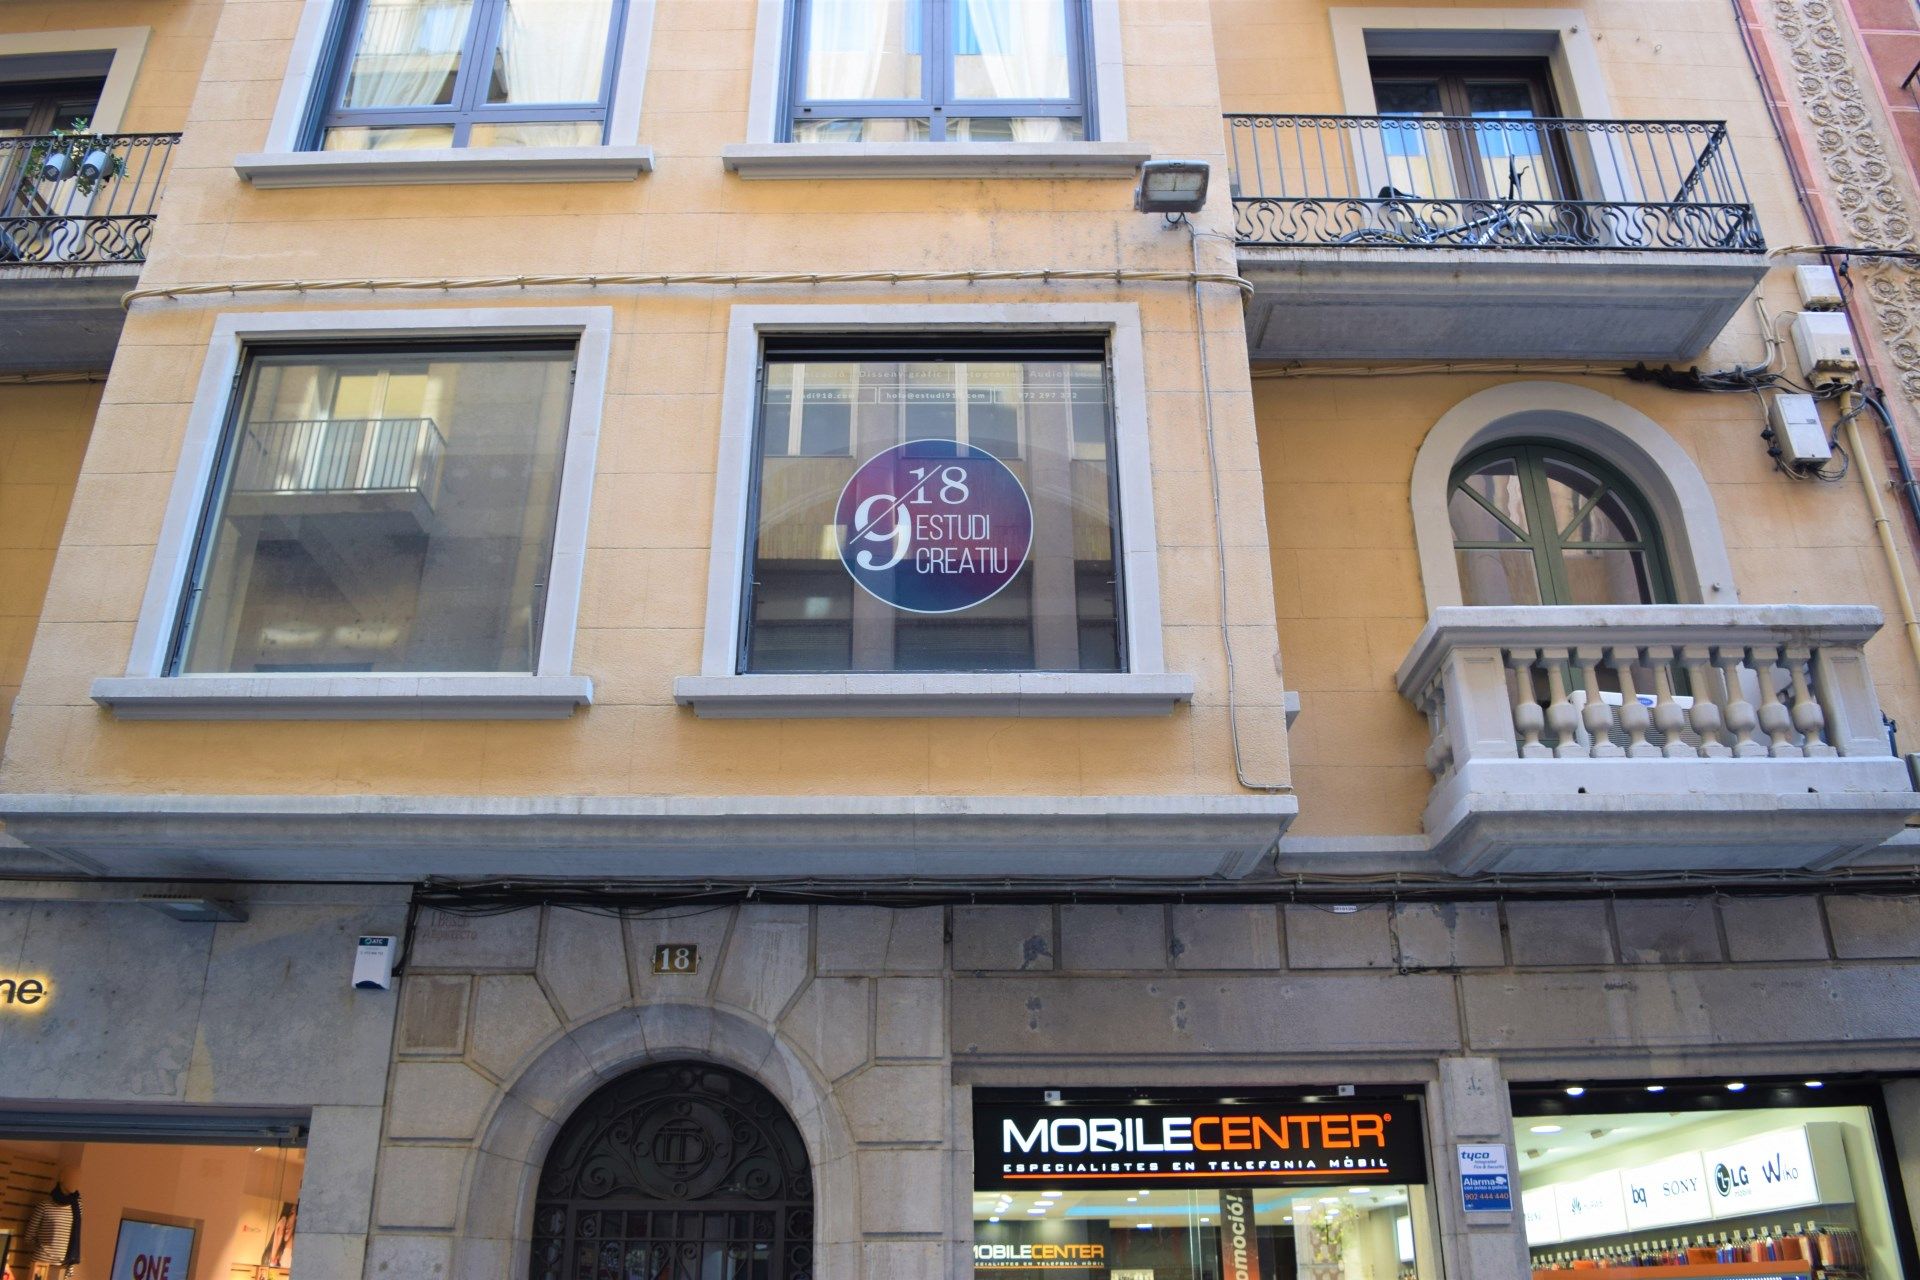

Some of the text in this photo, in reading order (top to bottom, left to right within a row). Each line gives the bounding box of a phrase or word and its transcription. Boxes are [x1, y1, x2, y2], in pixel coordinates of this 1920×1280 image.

[916, 514, 990, 540] ESTUDI
[916, 547, 1008, 574] CREATIU
[660, 947, 690, 970] 18
[1003, 1155, 1388, 1173] ESPECIALISTES EN TELEFONIA MÒBIL
[1461, 1151, 1490, 1161] tyco
[1463, 1177, 1496, 1186] Alarma
[1662, 1177, 1698, 1197] SONY
[1730, 1166, 1749, 1187] LG
[1630, 1183, 1648, 1208] bq
[133, 1253, 172, 1280] ONE
